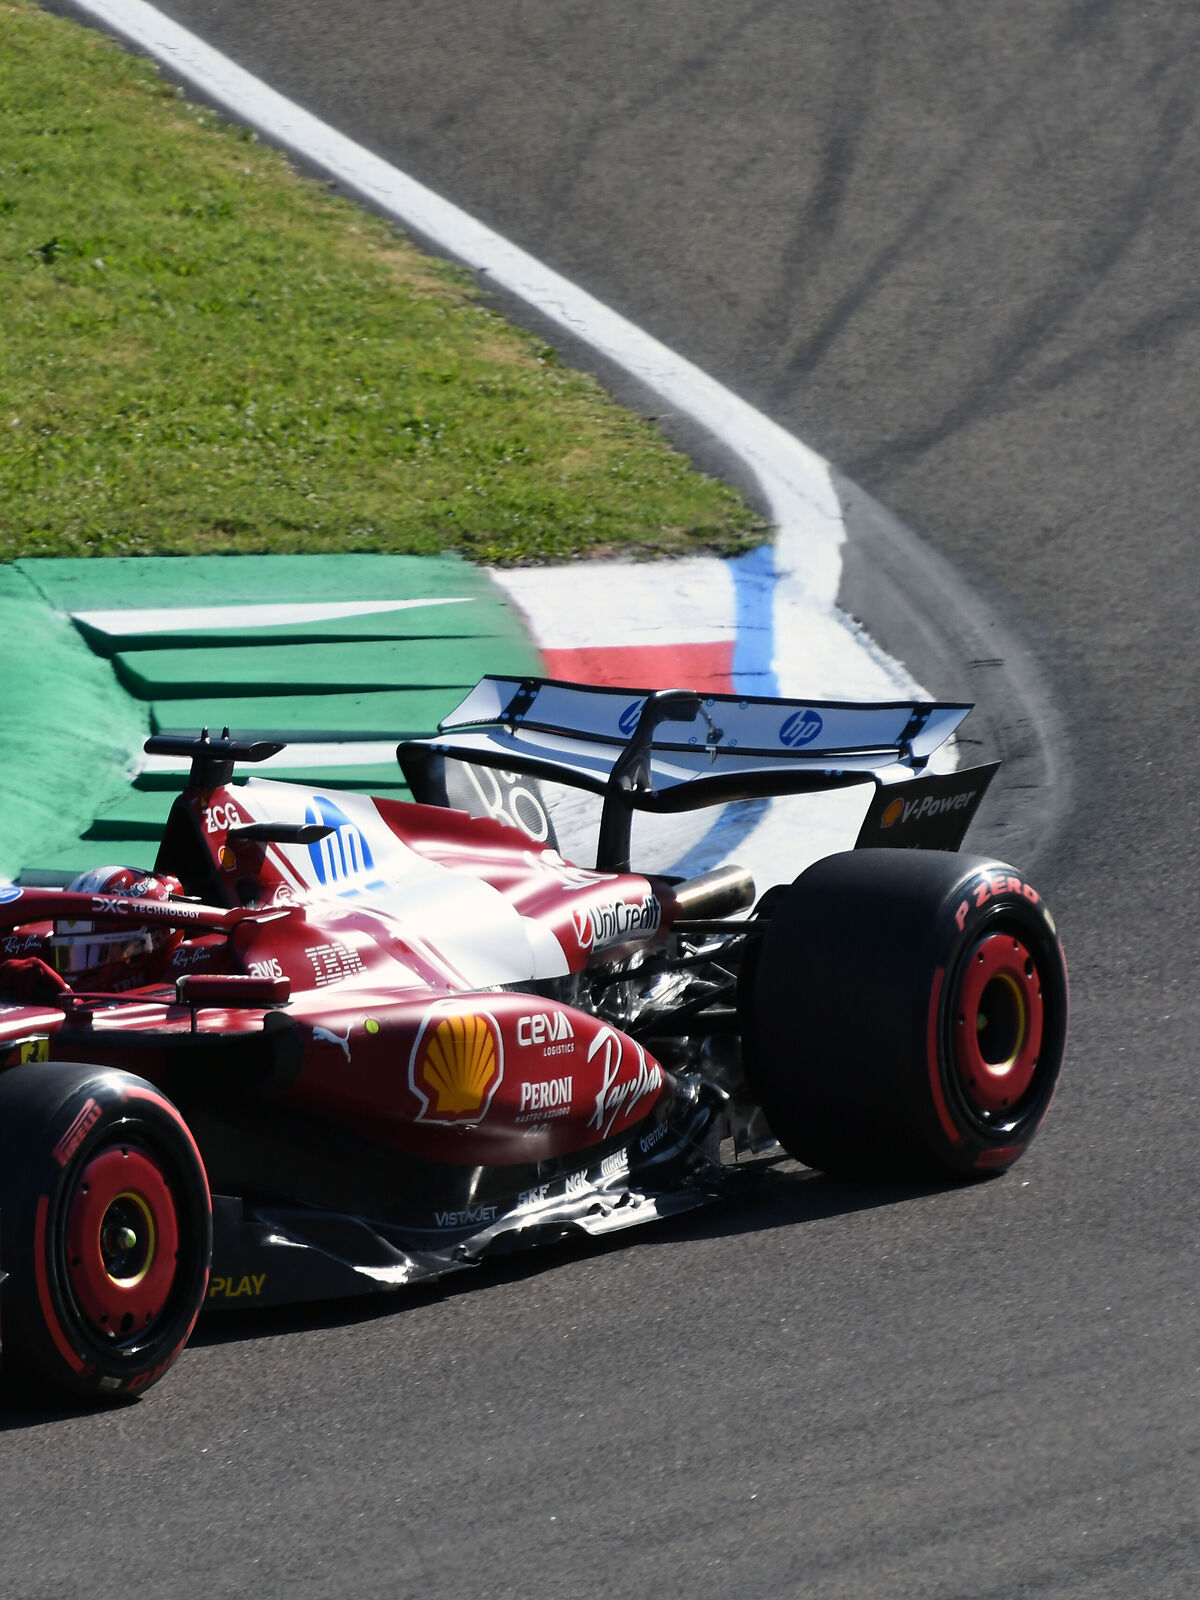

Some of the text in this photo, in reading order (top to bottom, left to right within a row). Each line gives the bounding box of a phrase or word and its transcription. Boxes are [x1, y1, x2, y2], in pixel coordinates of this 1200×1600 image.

[780, 710, 822, 747] hp
[901, 791, 977, 823] V-Power
[92, 896, 201, 919] DXC TECHNOLOGY
[589, 896, 661, 941] UniCredit
[955, 875, 1039, 932] P ZERO
[248, 958, 283, 979] aws
[305, 943, 368, 986] IBM
[543, 1043, 575, 1057] LOGISTICS
[520, 1076, 573, 1112] PERONI
[587, 1026, 663, 1140] Ray-Ban
[566, 1169, 593, 1193] NGK
[210, 1274, 267, 1298] PLAY
